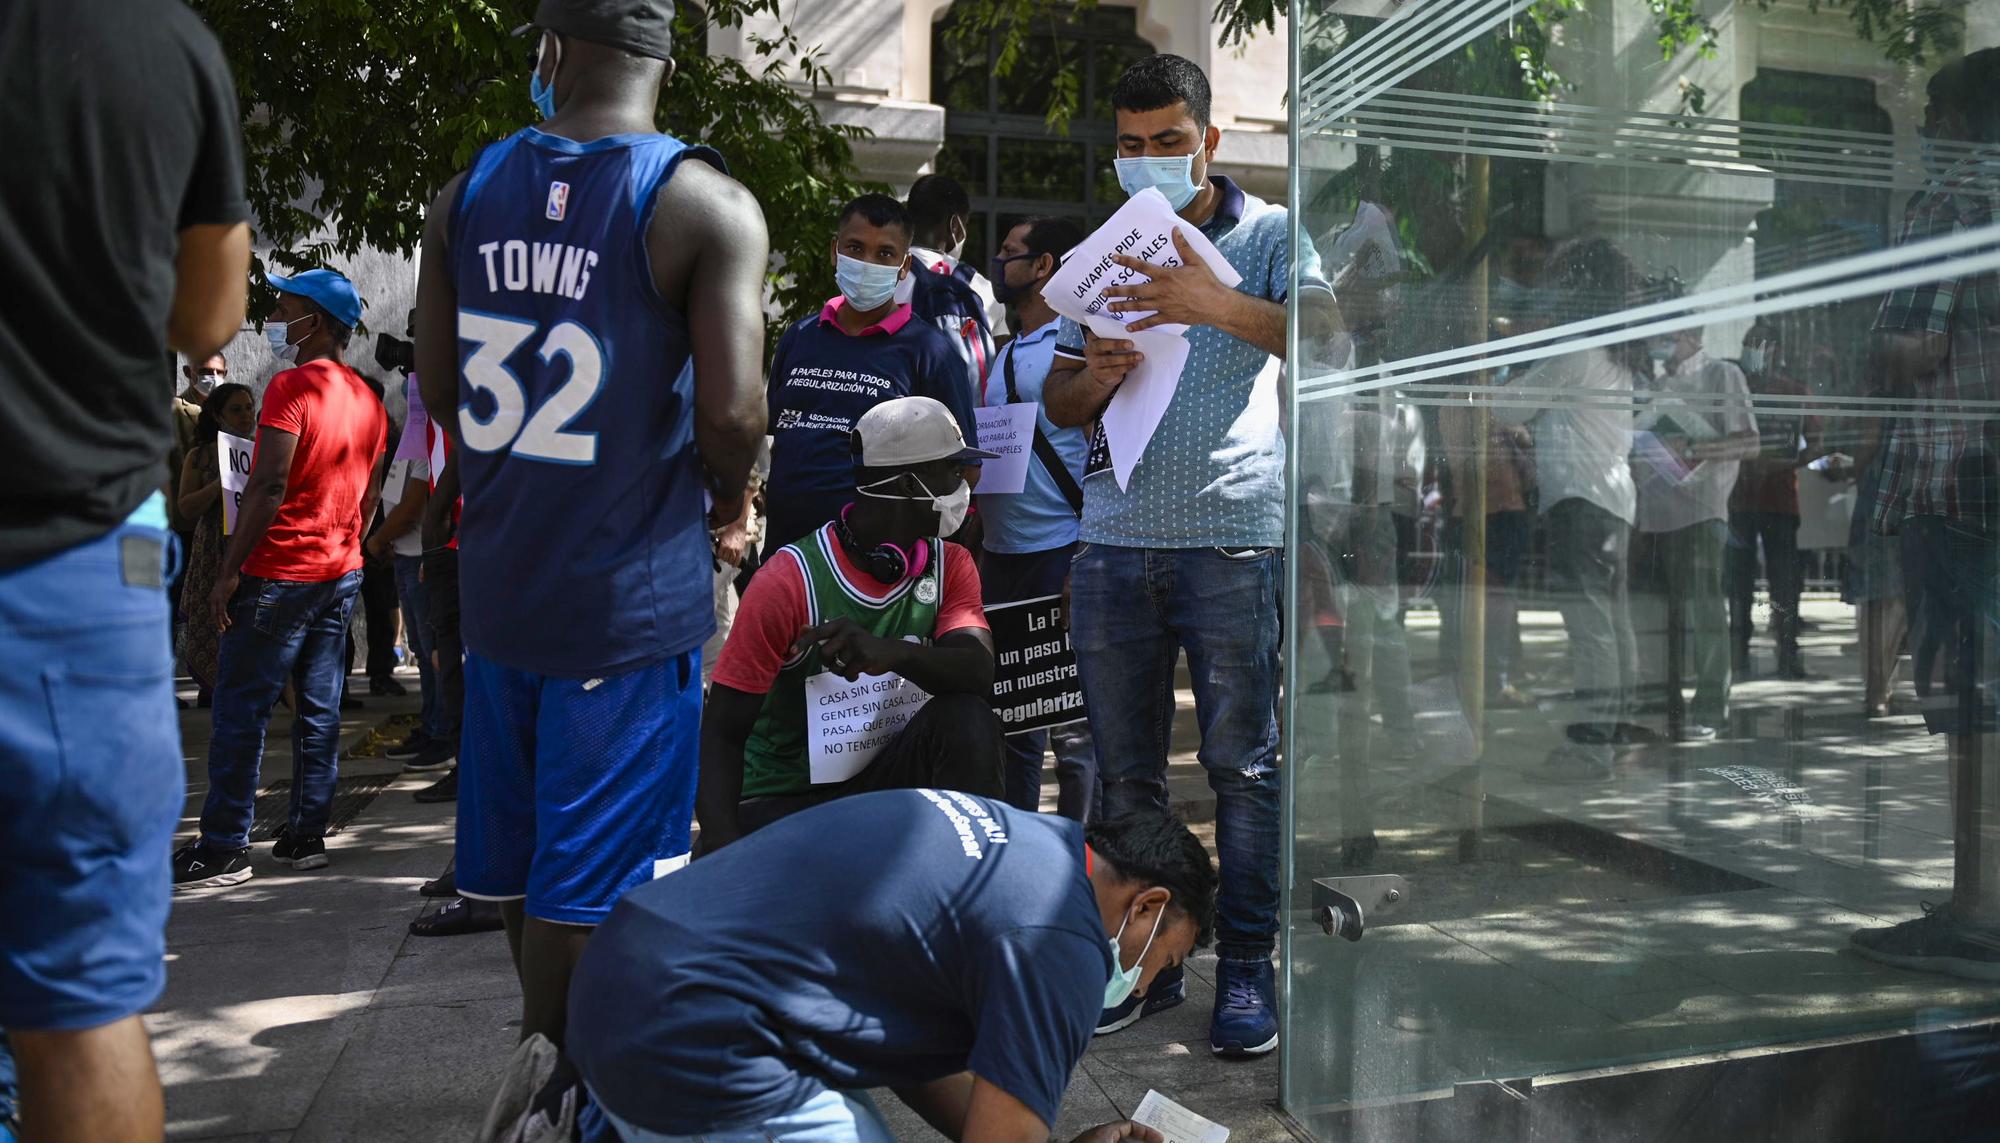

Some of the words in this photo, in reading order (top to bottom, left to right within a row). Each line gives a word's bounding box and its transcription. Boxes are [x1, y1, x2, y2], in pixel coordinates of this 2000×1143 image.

[1114, 228, 1143, 255] PIDE
[1118, 233, 1168, 283] SOALES
[478, 240, 598, 300] TOWNS
[458, 309, 605, 465] 32
[834, 369, 857, 381] PARA
[859, 373, 891, 389] TODOS
[866, 387, 878, 398] YA
[826, 423, 850, 433] BANGL
[976, 418, 1007, 430] ORMACIÓN
[1005, 431, 1017, 440] LAS
[229, 447, 251, 475] NO
[1028, 612, 1046, 632] La
[1050, 607, 1061, 627] P
[1000, 650, 1020, 666] un
[1024, 640, 1061, 665] paso
[993, 679, 1013, 696] en
[1017, 663, 1078, 690] nuestra
[819, 690, 849, 707] CASA
[851, 685, 870, 699] SIN
[821, 707, 860, 722] GENTE
[862, 701, 881, 714] SIN
[824, 743, 843, 755] NO
[848, 733, 891, 753] TENEMOS
